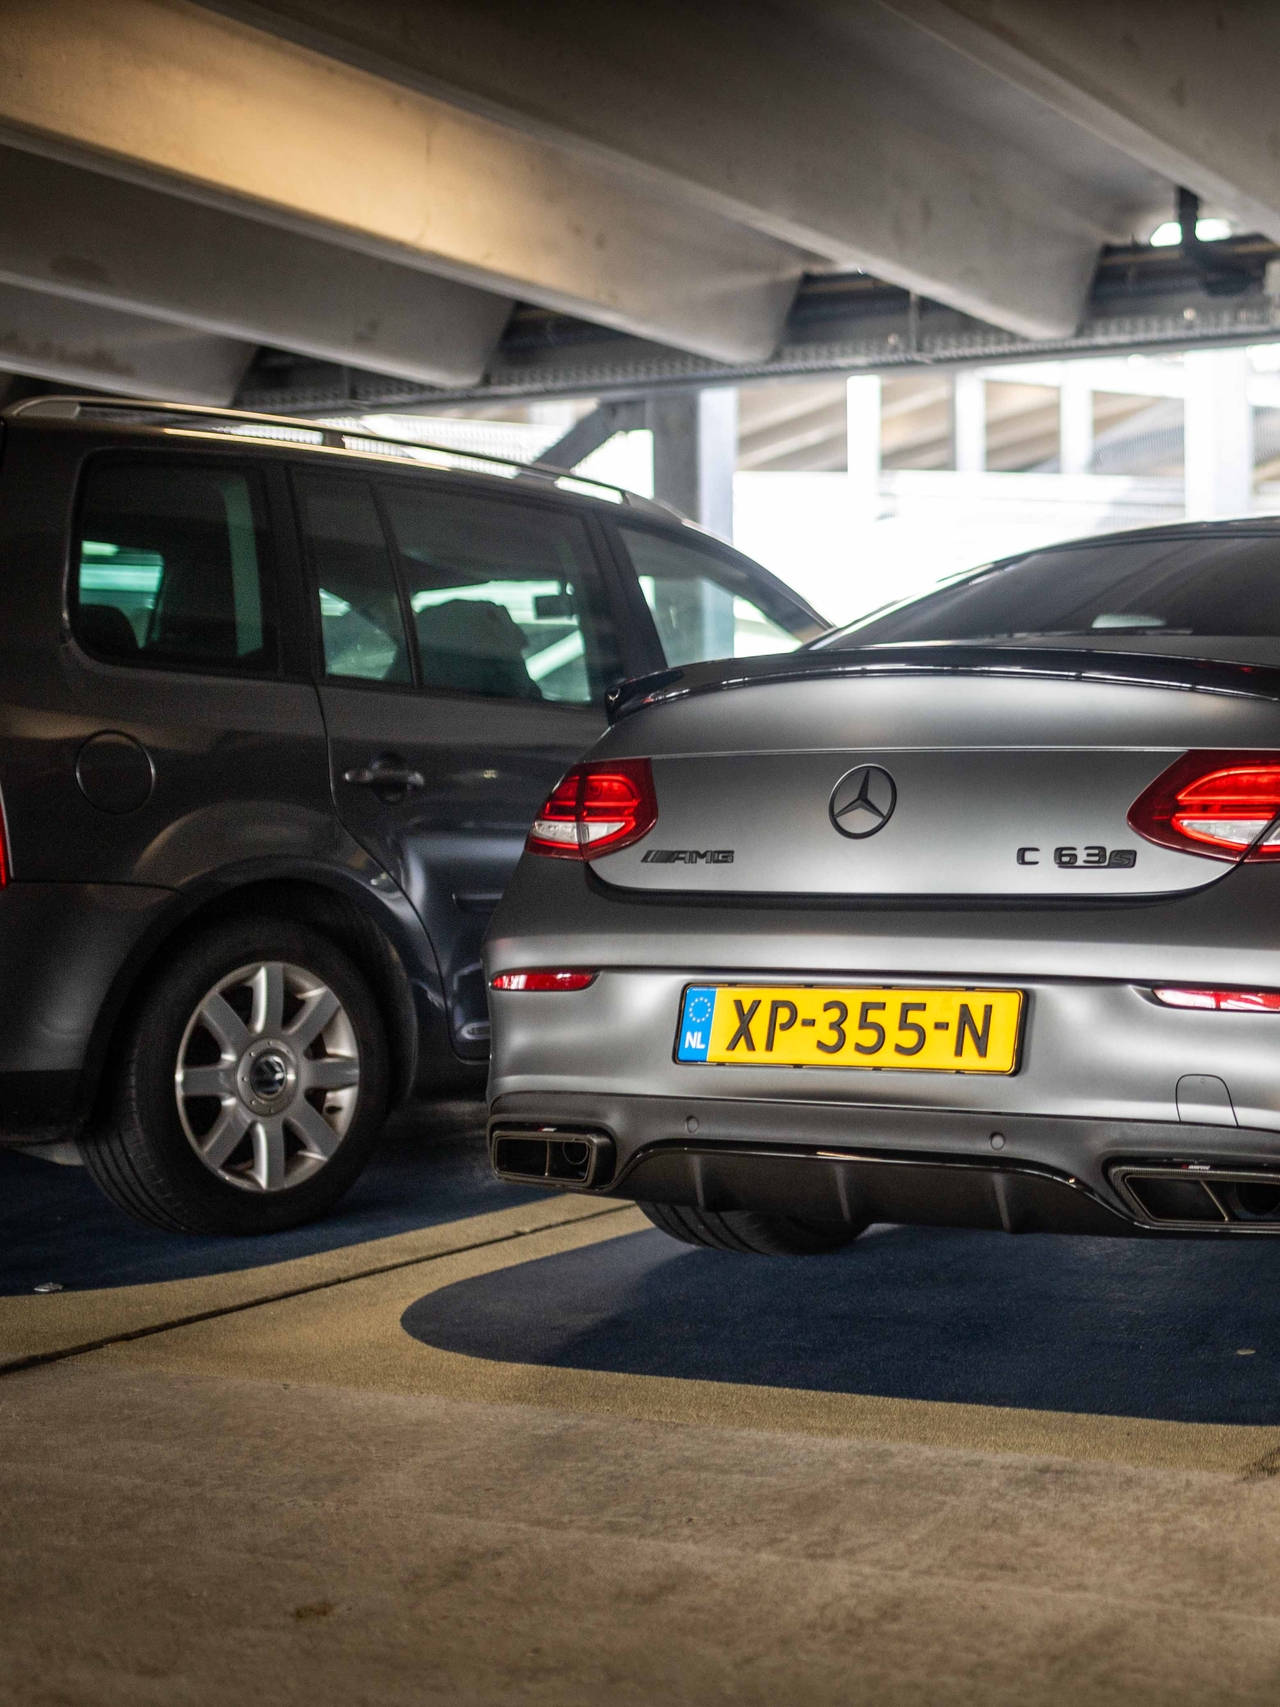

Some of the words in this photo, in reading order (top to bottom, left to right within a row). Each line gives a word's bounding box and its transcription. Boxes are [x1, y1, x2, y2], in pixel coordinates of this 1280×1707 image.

[1017, 847, 1040, 865] C
[685, 1031, 706, 1049] NL
[726, 999, 993, 1058] XP-355-N
